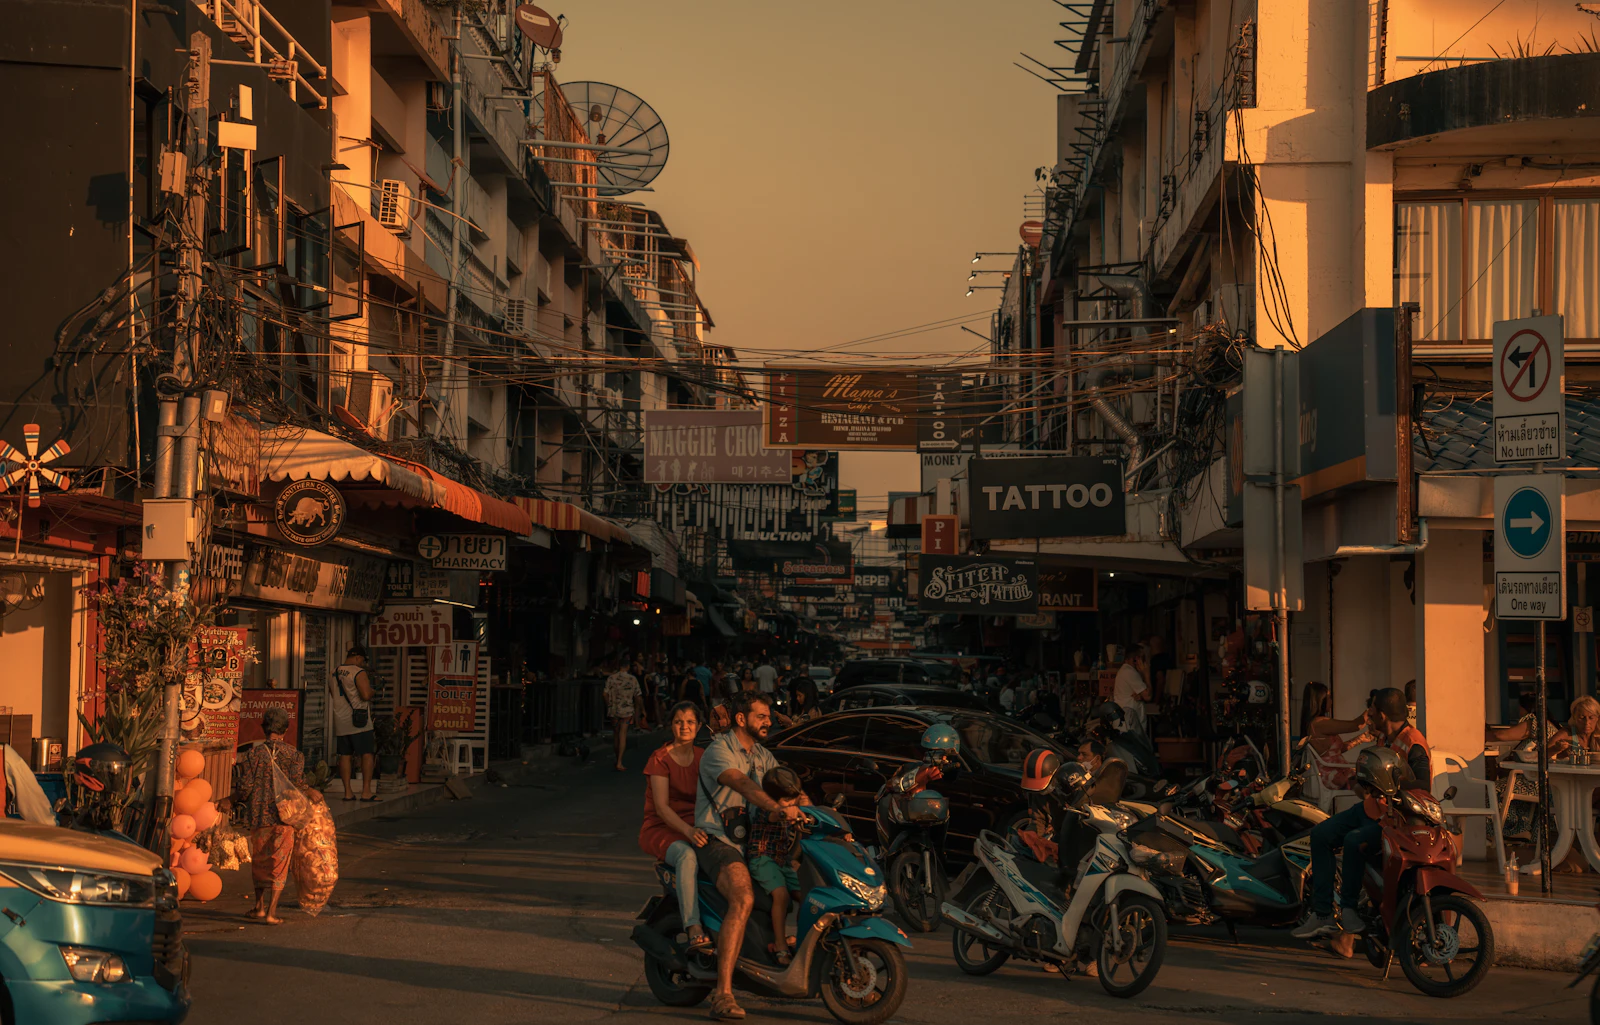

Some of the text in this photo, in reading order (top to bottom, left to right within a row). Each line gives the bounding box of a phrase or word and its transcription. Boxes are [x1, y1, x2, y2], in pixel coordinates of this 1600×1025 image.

[822, 374, 899, 399] Mama's
[821, 412, 876, 425] RESTAURANT
[1498, 418, 1557, 442] ห้ามเลี้ยวซ้าย
[650, 426, 786, 457] MAGGIE CHO
[1501, 443, 1553, 458] No turn left
[924, 454, 963, 466] MONEY
[731, 466, 787, 478] 매기추스
[282, 481, 337, 504] SOUTHERN COFFEE
[982, 482, 1113, 511] TATTOO
[738, 531, 812, 542] EDUCTION
[439, 536, 504, 556] ขายยา
[434, 558, 505, 569] PHARMACY
[782, 561, 846, 576] Screamers
[1498, 577, 1558, 595] เดินรถทางเดียว
[978, 582, 1033, 606] TATTOO
[1511, 599, 1546, 613] One way
[393, 606, 424, 622] อาบน้ำ
[370, 609, 452, 645] ห้องน้ำ
[434, 690, 473, 699] TOILET
[248, 700, 286, 710] TANYADA
[433, 701, 471, 715] ห้องน้ำ
[433, 716, 468, 729] อาบน้ำ
